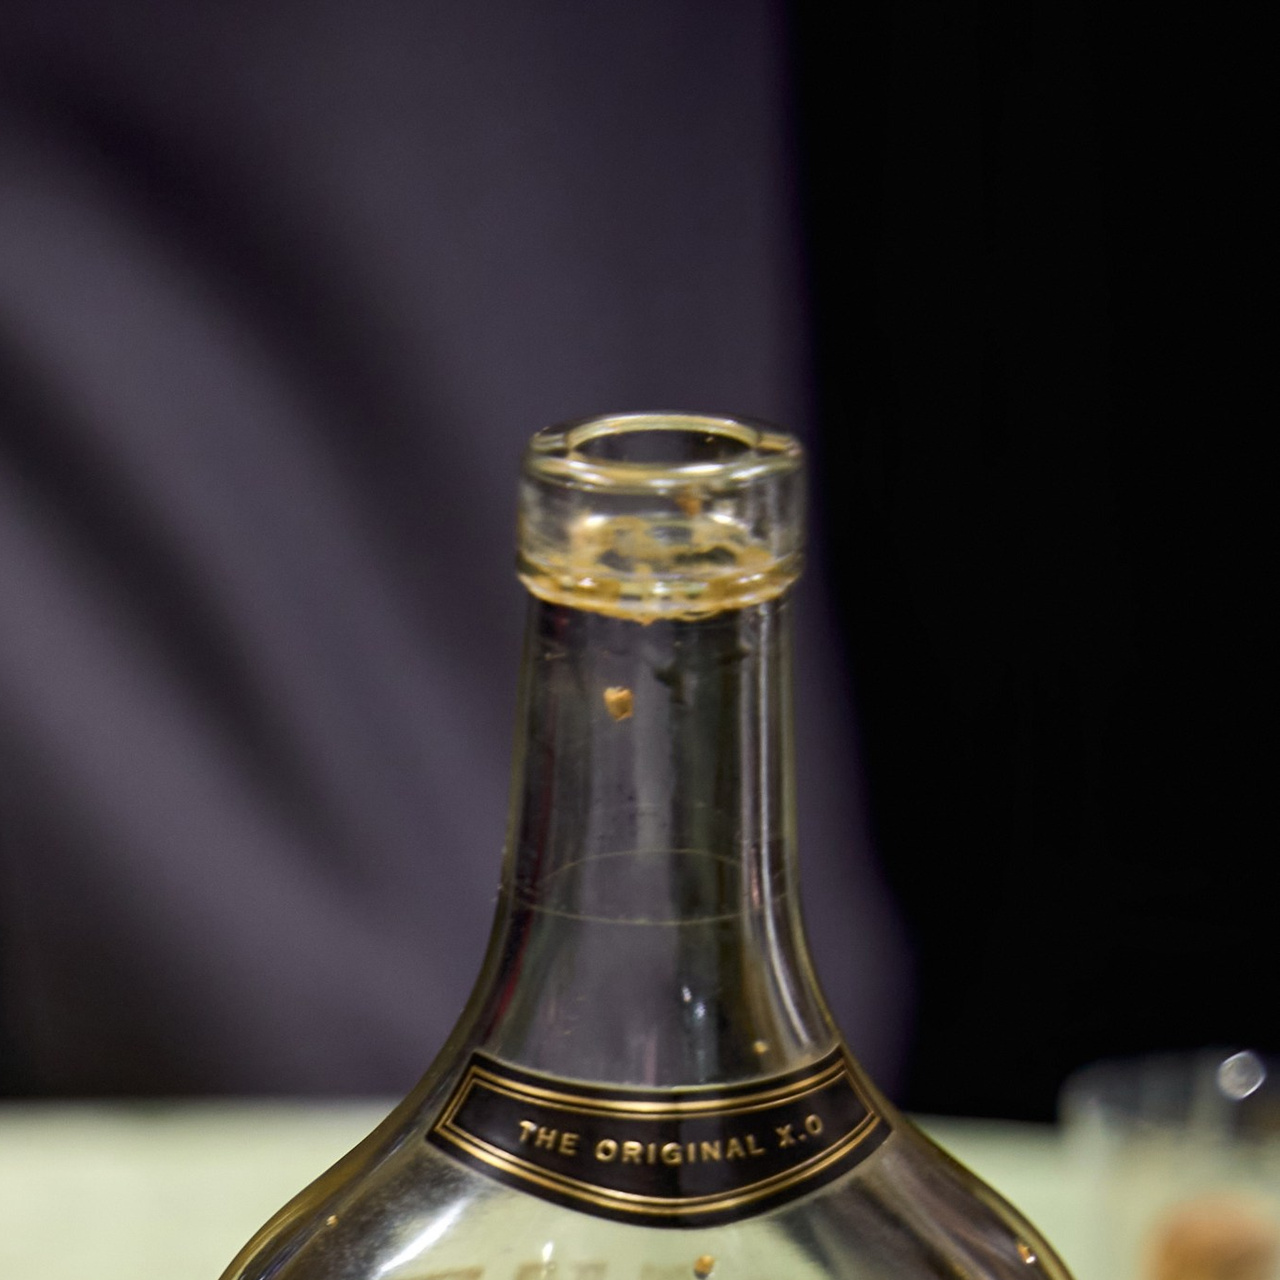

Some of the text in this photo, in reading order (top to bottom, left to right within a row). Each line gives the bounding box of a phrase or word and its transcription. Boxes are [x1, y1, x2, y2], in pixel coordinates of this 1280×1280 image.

[518, 1114, 824, 1166] THE ORIGINAL X.O
